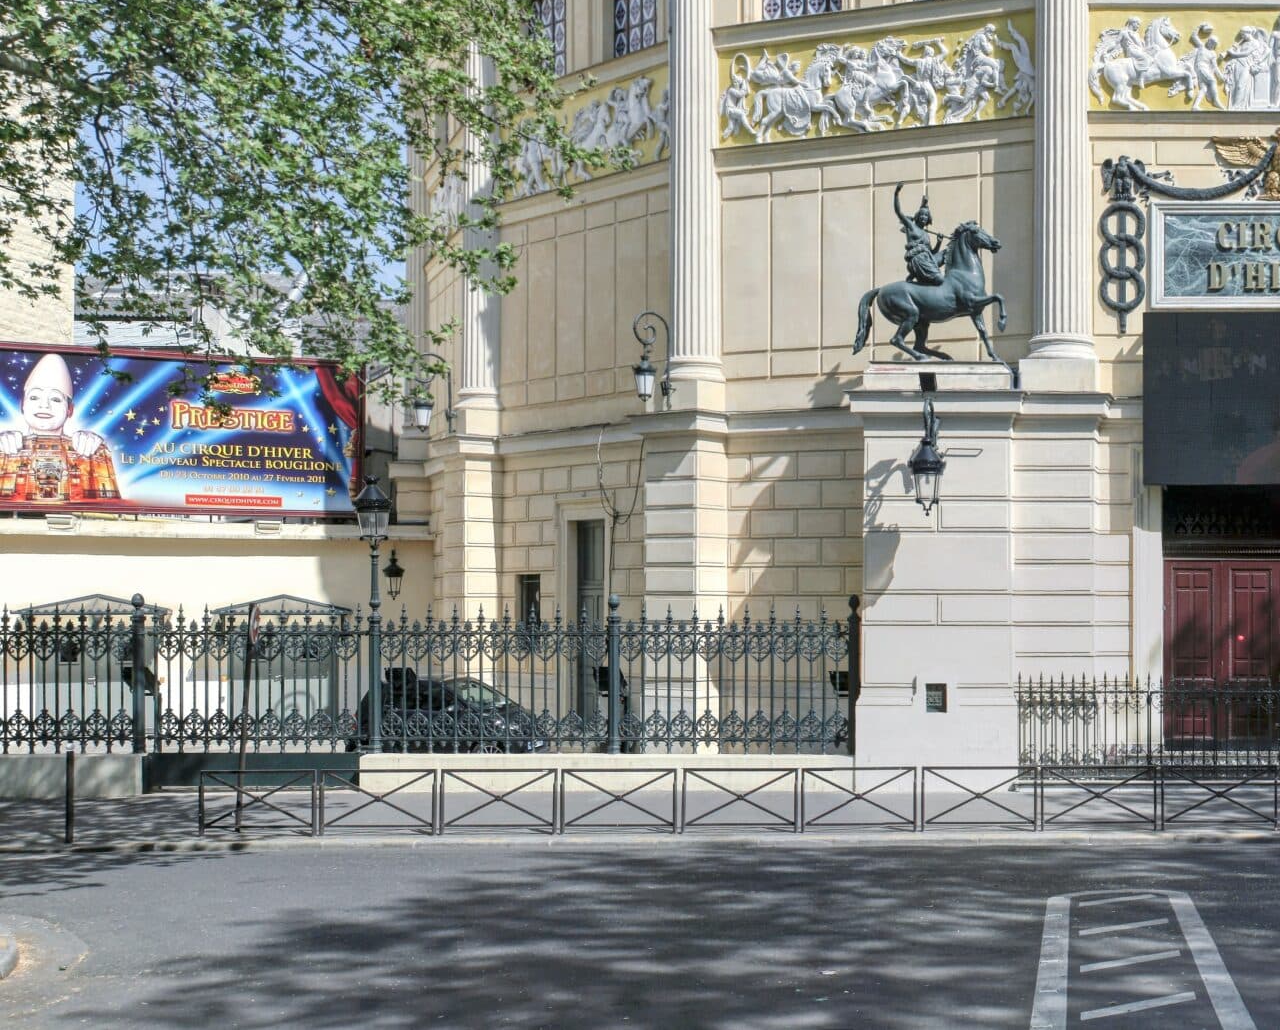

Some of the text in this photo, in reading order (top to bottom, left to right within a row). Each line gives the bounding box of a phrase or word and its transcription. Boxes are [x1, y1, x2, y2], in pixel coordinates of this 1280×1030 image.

[172, 401, 294, 431] PRESTIGE
[152, 442, 314, 459] AU CIRQUE D'HIVER
[265, 459, 343, 472] BOUGLIONE
[228, 472, 250, 481] 2010
[263, 473, 274, 482] 27
[307, 475, 326, 484] 2011
